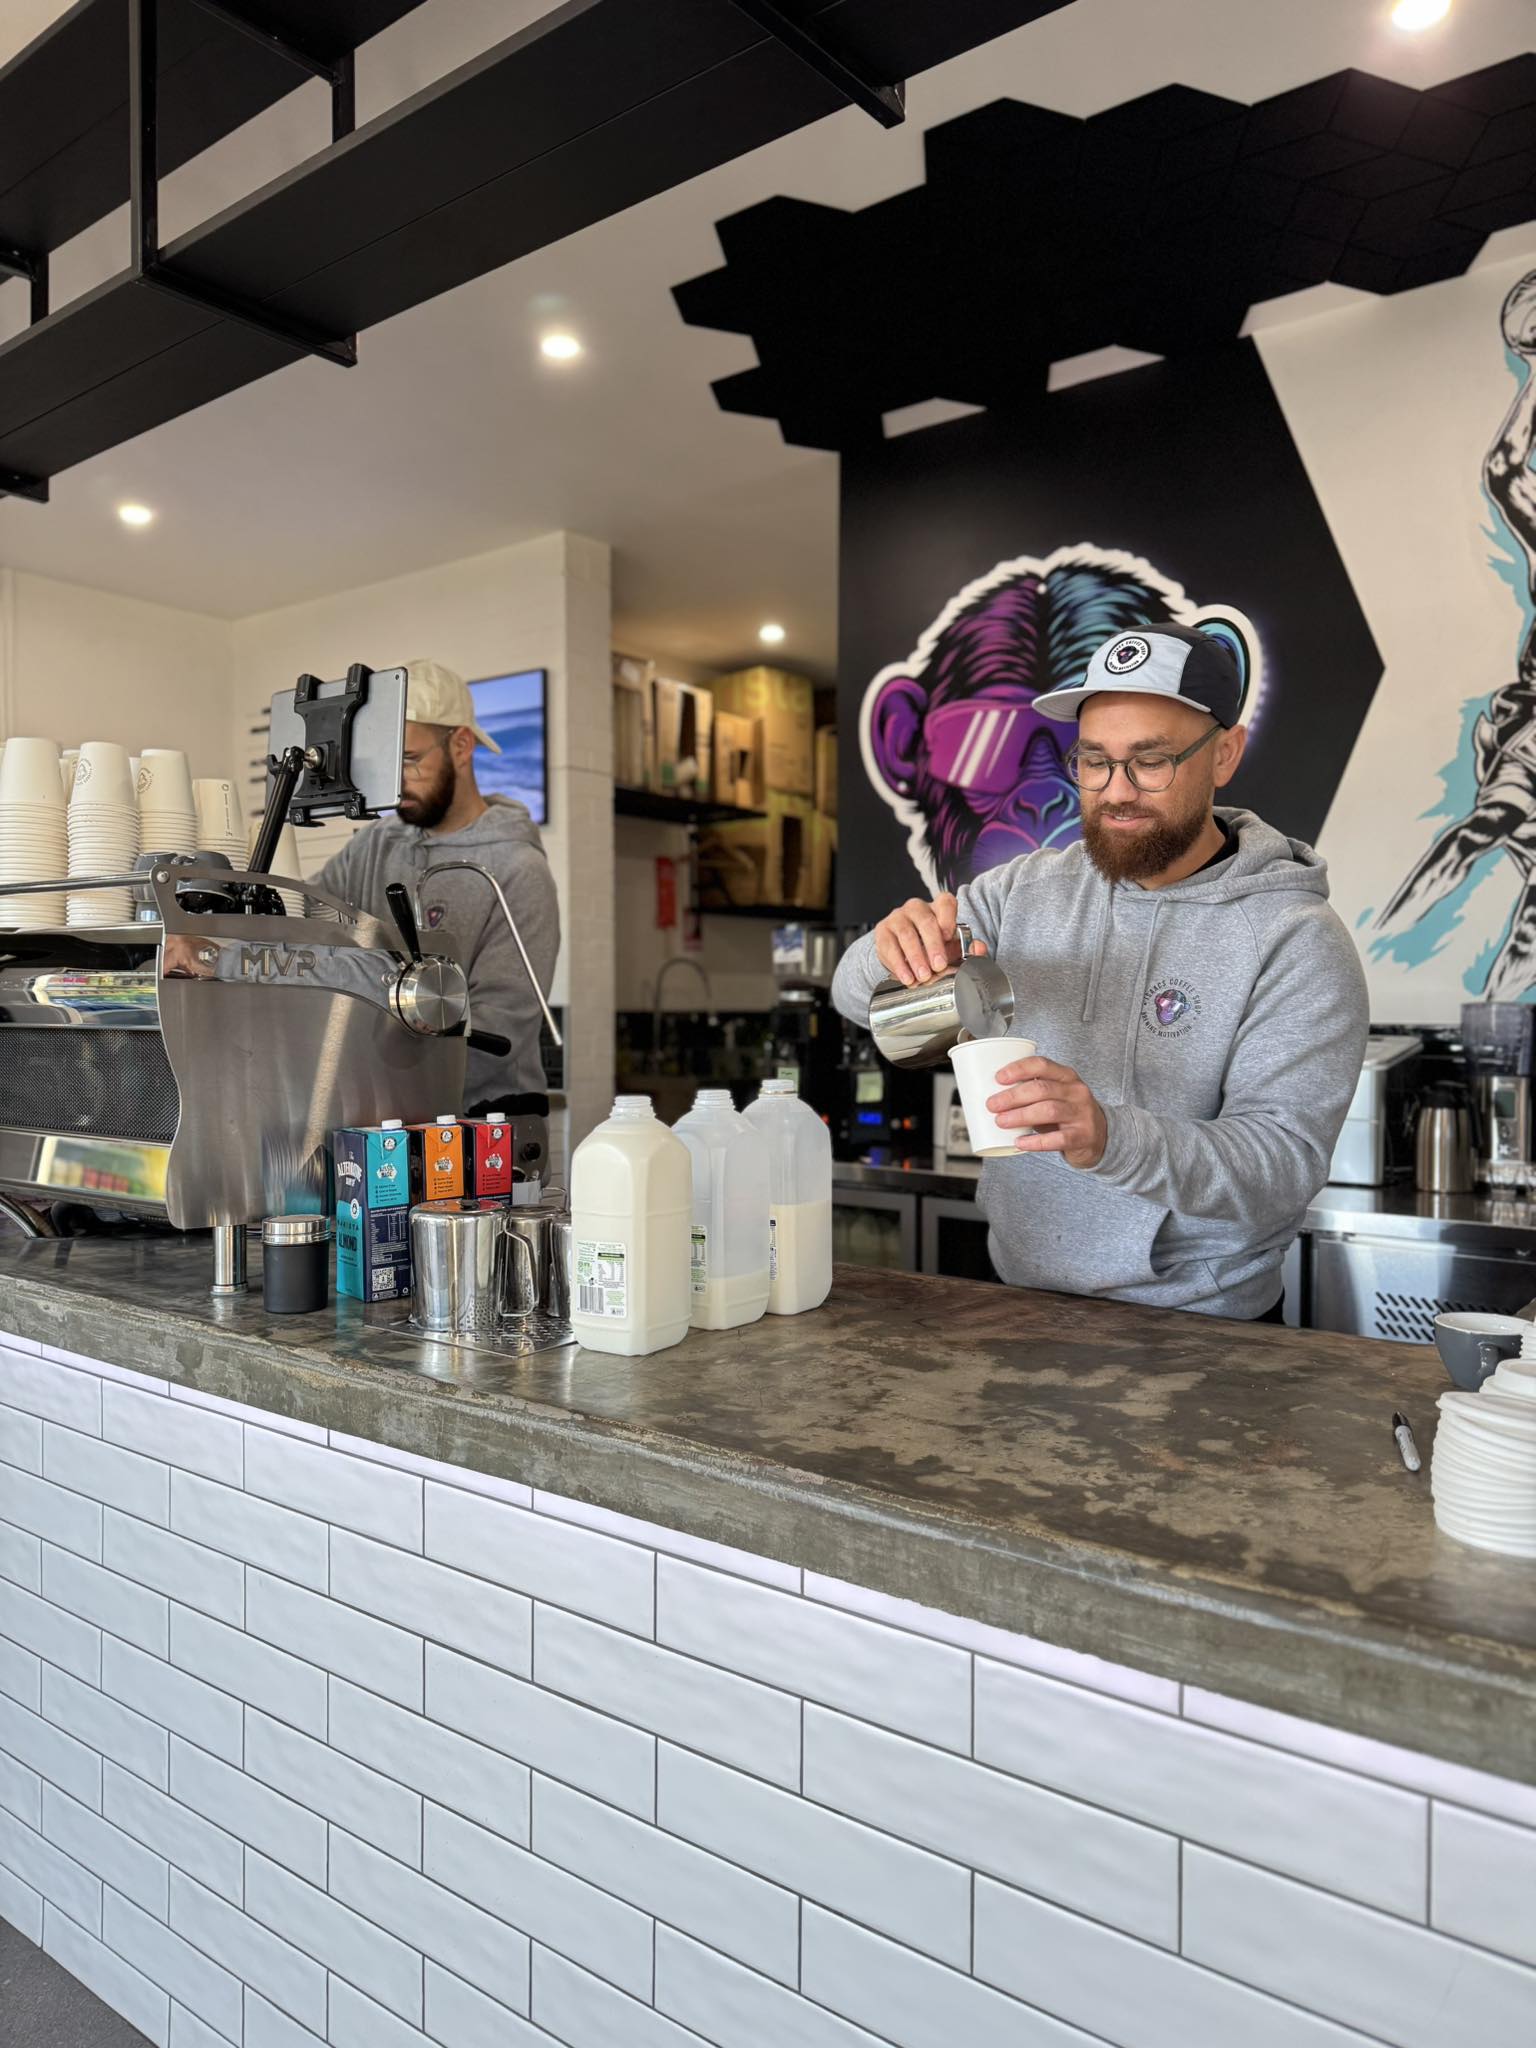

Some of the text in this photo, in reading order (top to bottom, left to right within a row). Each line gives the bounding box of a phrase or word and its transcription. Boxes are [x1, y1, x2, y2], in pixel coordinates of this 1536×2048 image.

[240, 947, 316, 977] MVP
[1144, 978, 1202, 1015] ISAACS COFFEE SHOP
[1158, 1025, 1192, 1038] MOTIVATION
